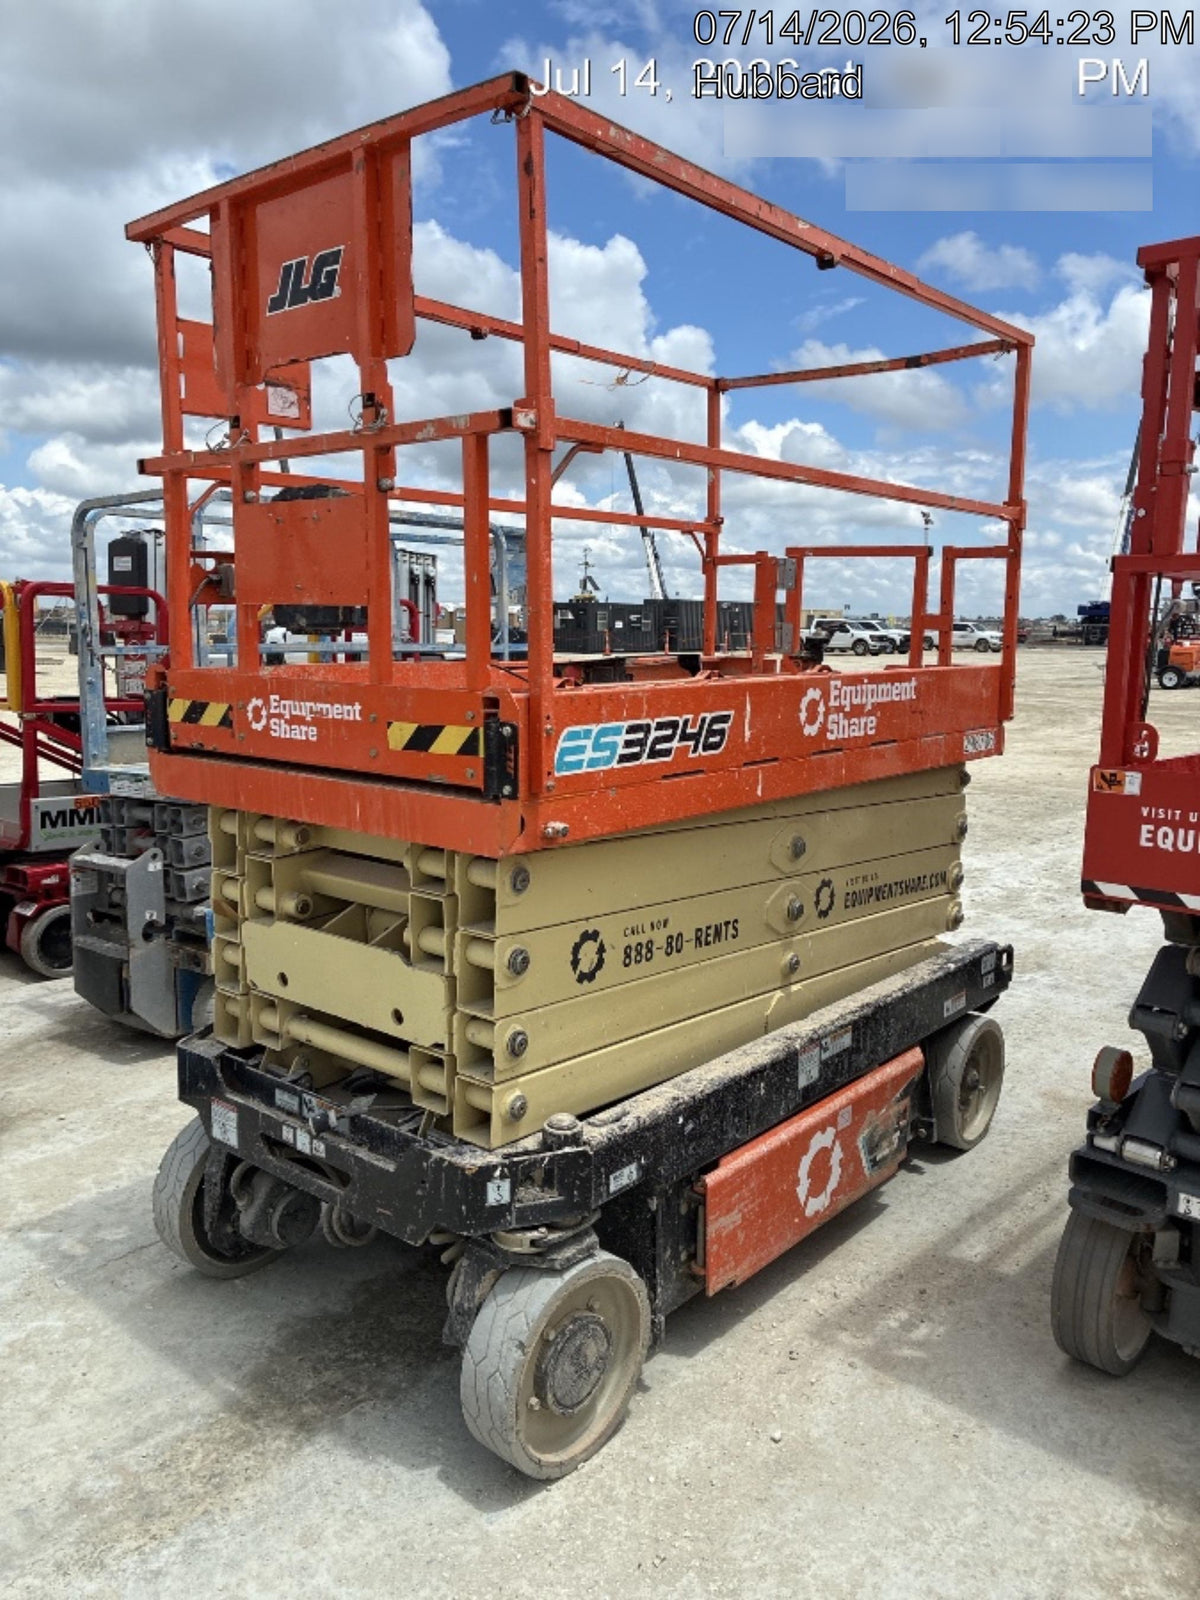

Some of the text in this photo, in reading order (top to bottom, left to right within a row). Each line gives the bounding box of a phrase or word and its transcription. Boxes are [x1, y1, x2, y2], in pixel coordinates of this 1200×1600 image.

[266, 245, 345, 317] JLG
[269, 694, 362, 721] Equipment
[828, 677, 918, 713] Equipment
[269, 718, 318, 742] Share
[826, 712, 878, 740] Share
[554, 710, 736, 776] ES3246
[1140, 806, 1182, 821] VISIT
[623, 917, 670, 938] CALL NOW
[622, 918, 740, 968] 888-80-RENTS
